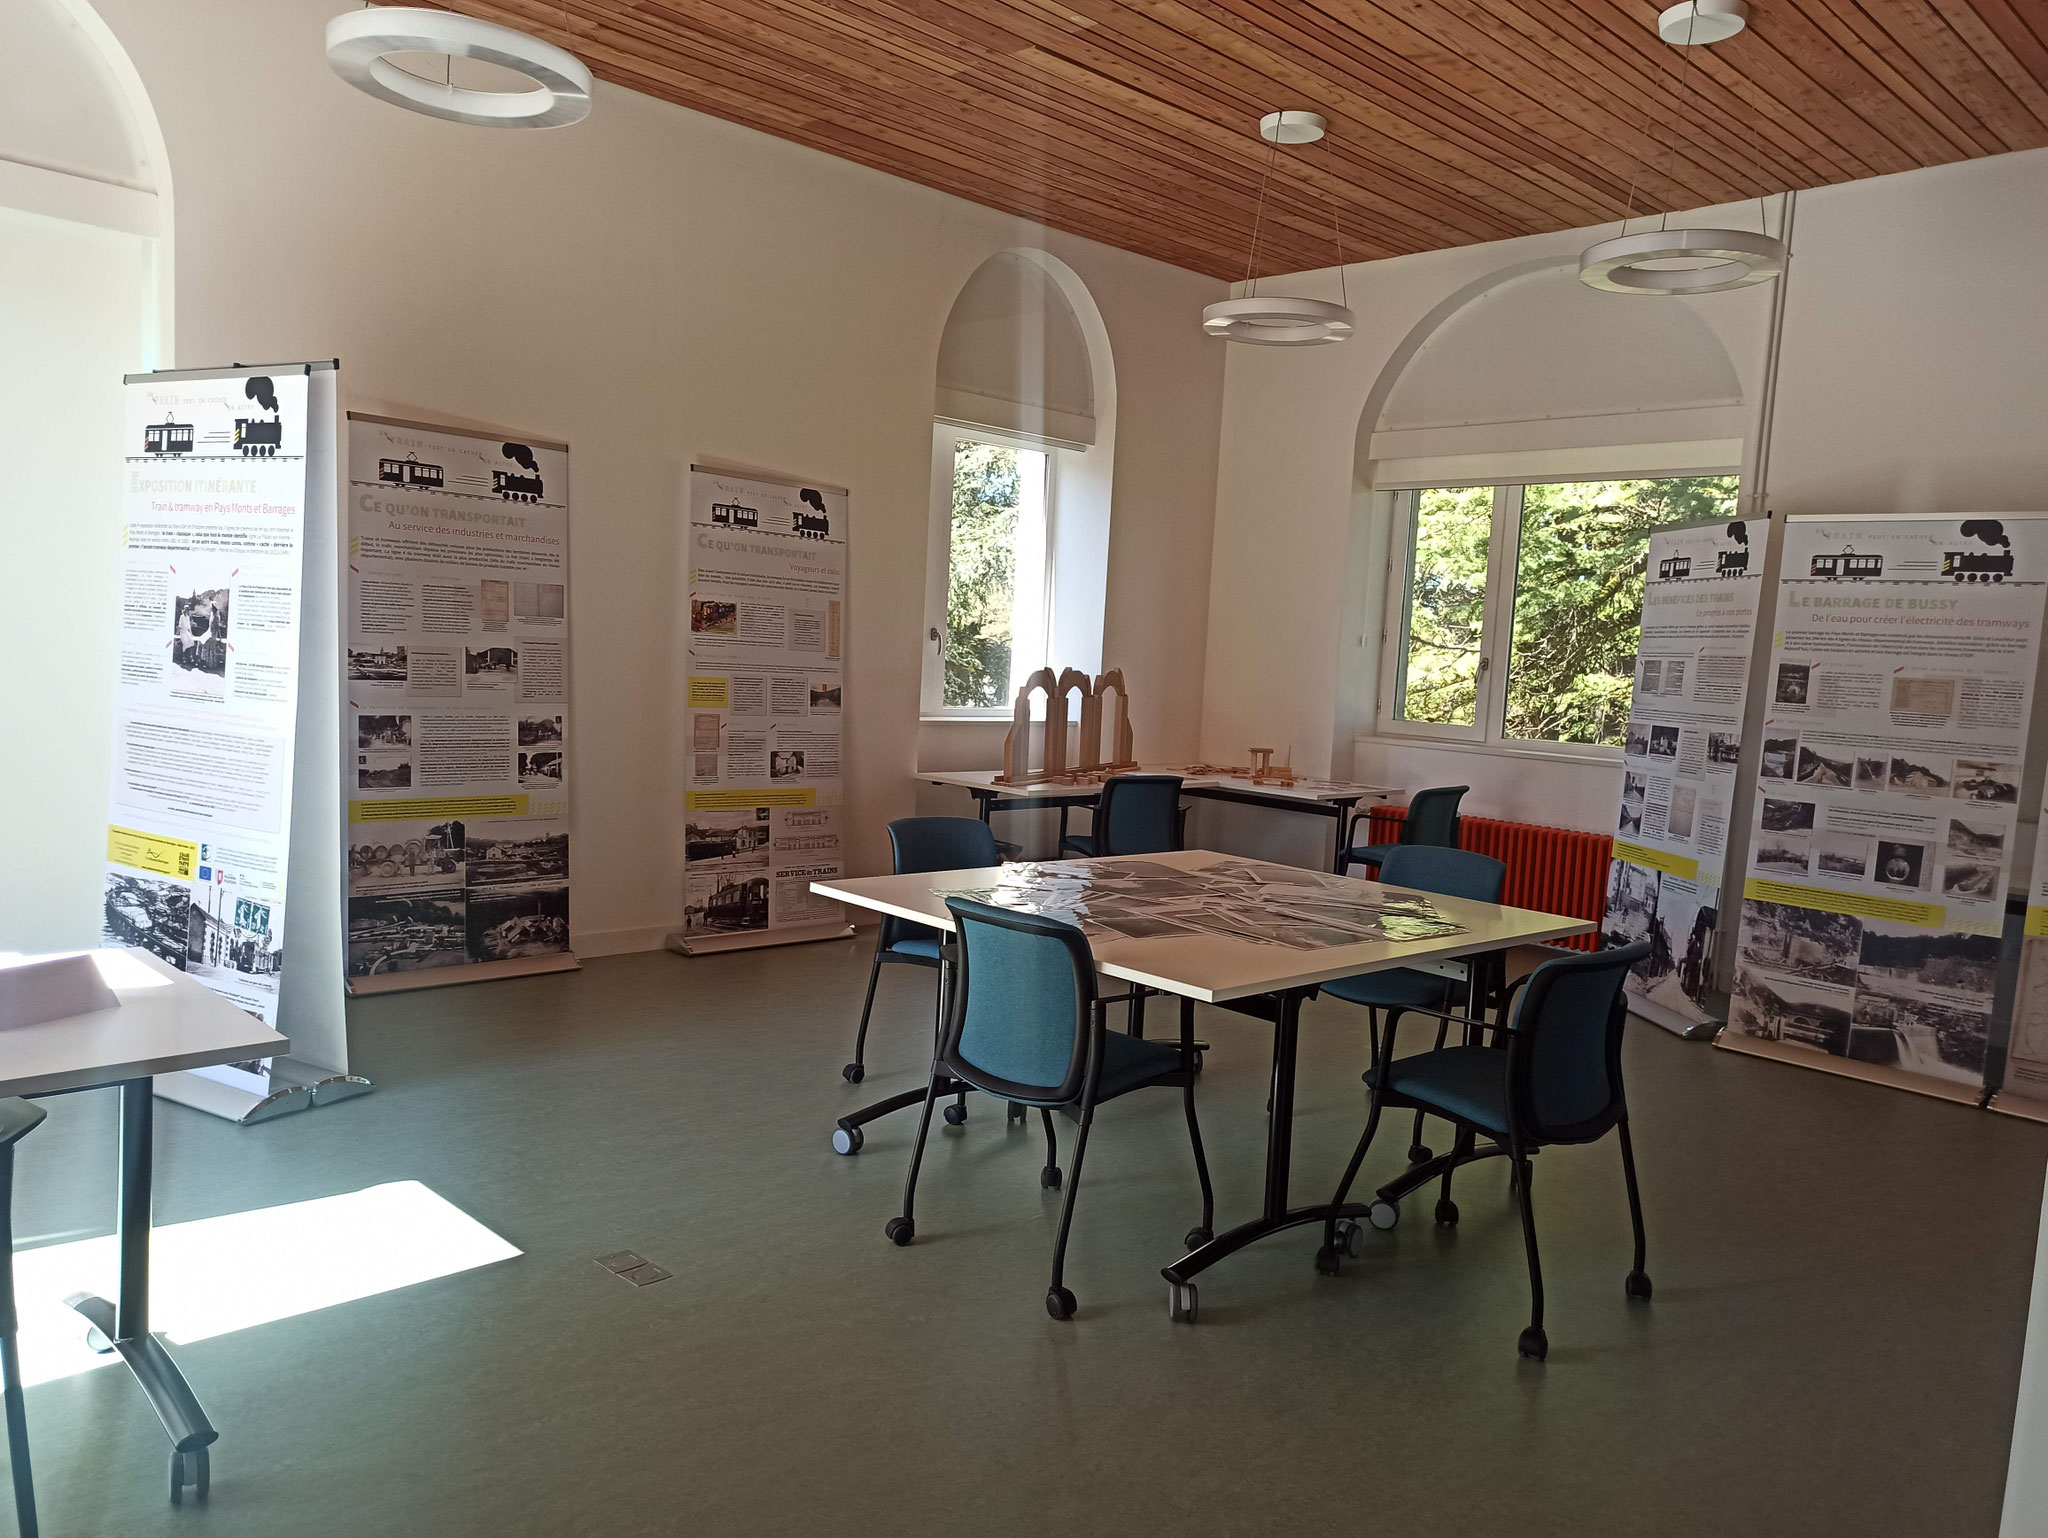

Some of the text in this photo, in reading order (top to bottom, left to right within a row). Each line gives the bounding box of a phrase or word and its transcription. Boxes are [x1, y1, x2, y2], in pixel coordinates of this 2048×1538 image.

[131, 471, 256, 494] EXPOSITION ITINÉRANTE
[152, 501, 296, 517] Train & tramway en Pays Monts et Barrages
[385, 502, 429, 518] QU'ON
[432, 508, 526, 528] TRANSPORTAIT
[388, 520, 560, 546] Au service des industries et marchandises
[716, 541, 748, 553] QU'ON
[750, 545, 816, 561] TRANSPORTAIT
[789, 563, 820, 574] Voyageurs
[820, 566, 827, 574] et
[1662, 593, 1695, 605] BÉNÉFICES
[1696, 593, 1707, 603] DES
[1710, 592, 1734, 603] TRAINS
[1789, 590, 1958, 610] LE BARRAGE DE BUSSY
[1736, 609, 1752, 617] portes
[1812, 614, 2030, 630] De l'eau pour créer l'électricité des tramways
[776, 870, 806, 878] SERVICE
